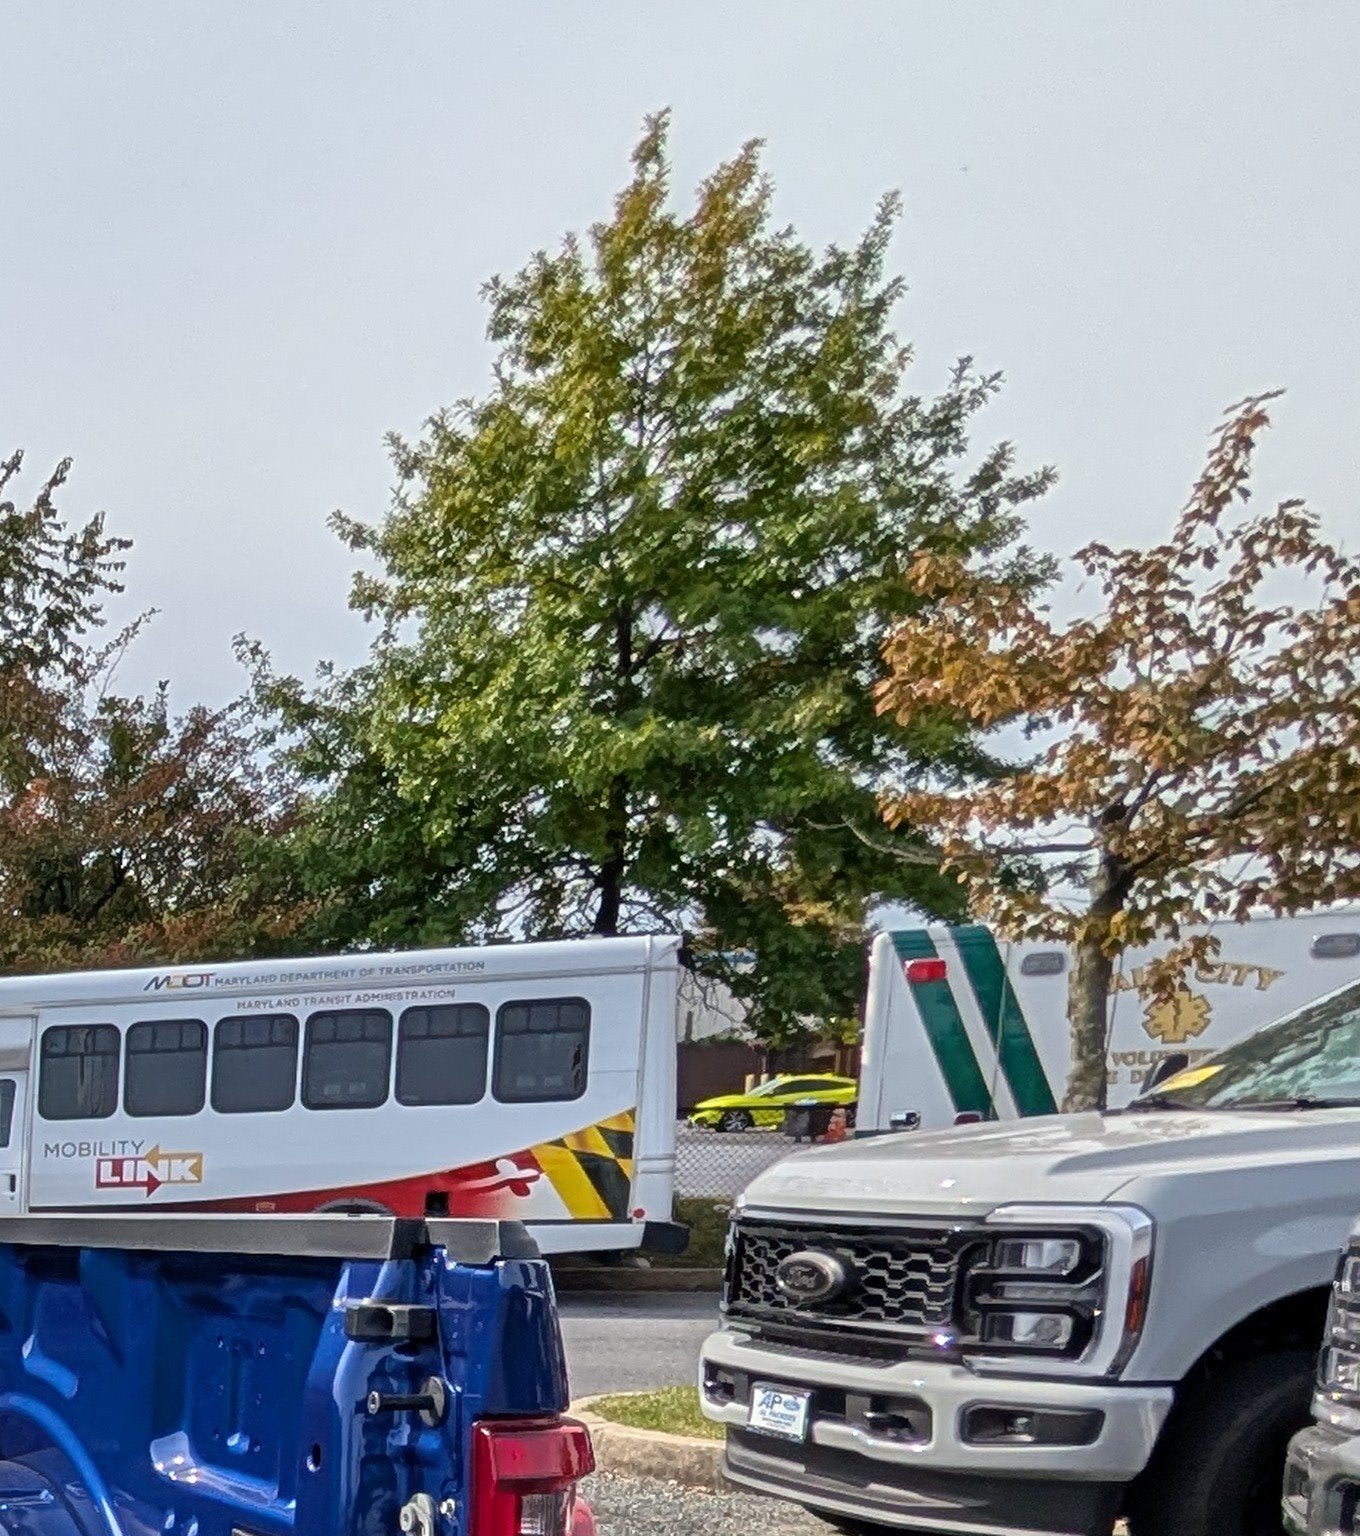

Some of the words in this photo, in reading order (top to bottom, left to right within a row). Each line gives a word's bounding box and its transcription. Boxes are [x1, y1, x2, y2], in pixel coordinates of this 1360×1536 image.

[215, 974, 277, 986] MARYLAND
[281, 969, 356, 983] DEPARTMENT
[359, 967, 376, 977] OF
[379, 961, 485, 976] TRANSPORTATION
[237, 999, 299, 1010] MARYLAND
[304, 995, 352, 1006] TRANSIT
[355, 989, 456, 1003] ADMINISTRATION
[43, 1139, 145, 1158] MOBILITY
[100, 1158, 198, 1183] LINK
